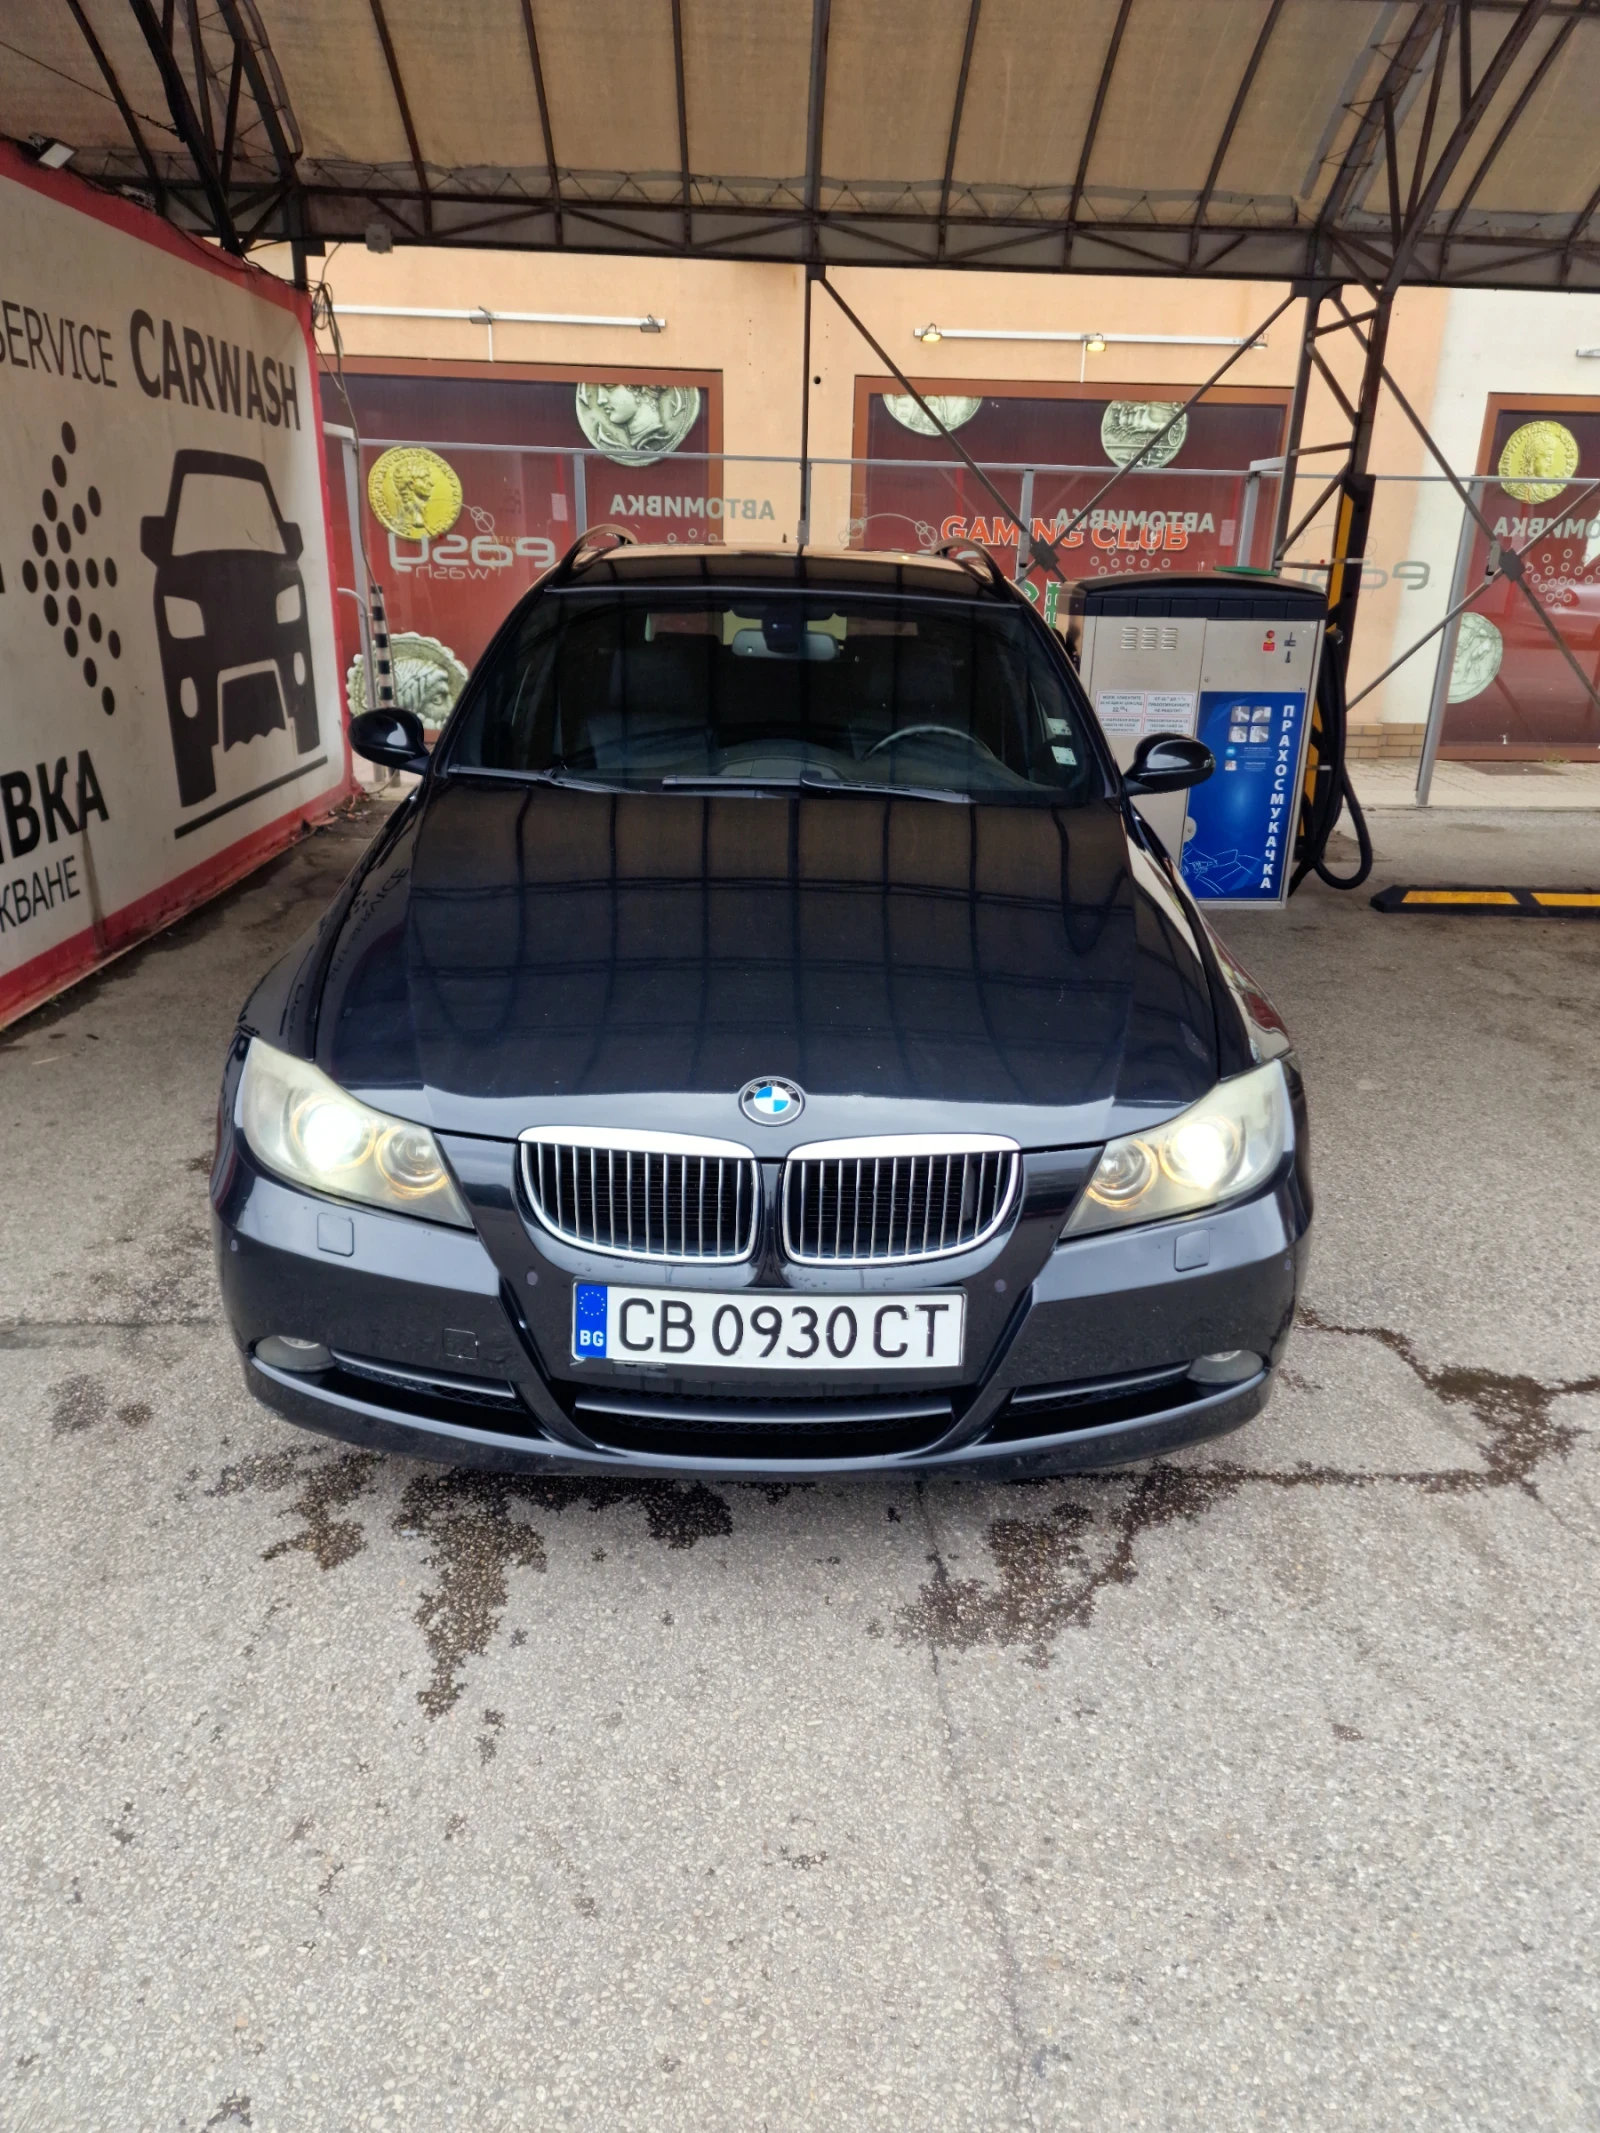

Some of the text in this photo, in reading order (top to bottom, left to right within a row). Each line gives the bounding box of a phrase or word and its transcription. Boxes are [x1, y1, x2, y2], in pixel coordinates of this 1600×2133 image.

[0, 299, 301, 431] ERVICE CARWASH
[941, 514, 1189, 551] GAMNG CLUB
[1259, 704, 1295, 889] ПРАХОСМУКАЧКА
[748, 1079, 797, 1095] BMW
[579, 1329, 605, 1348] BG
[618, 1297, 951, 1360] CB 0930 CT
